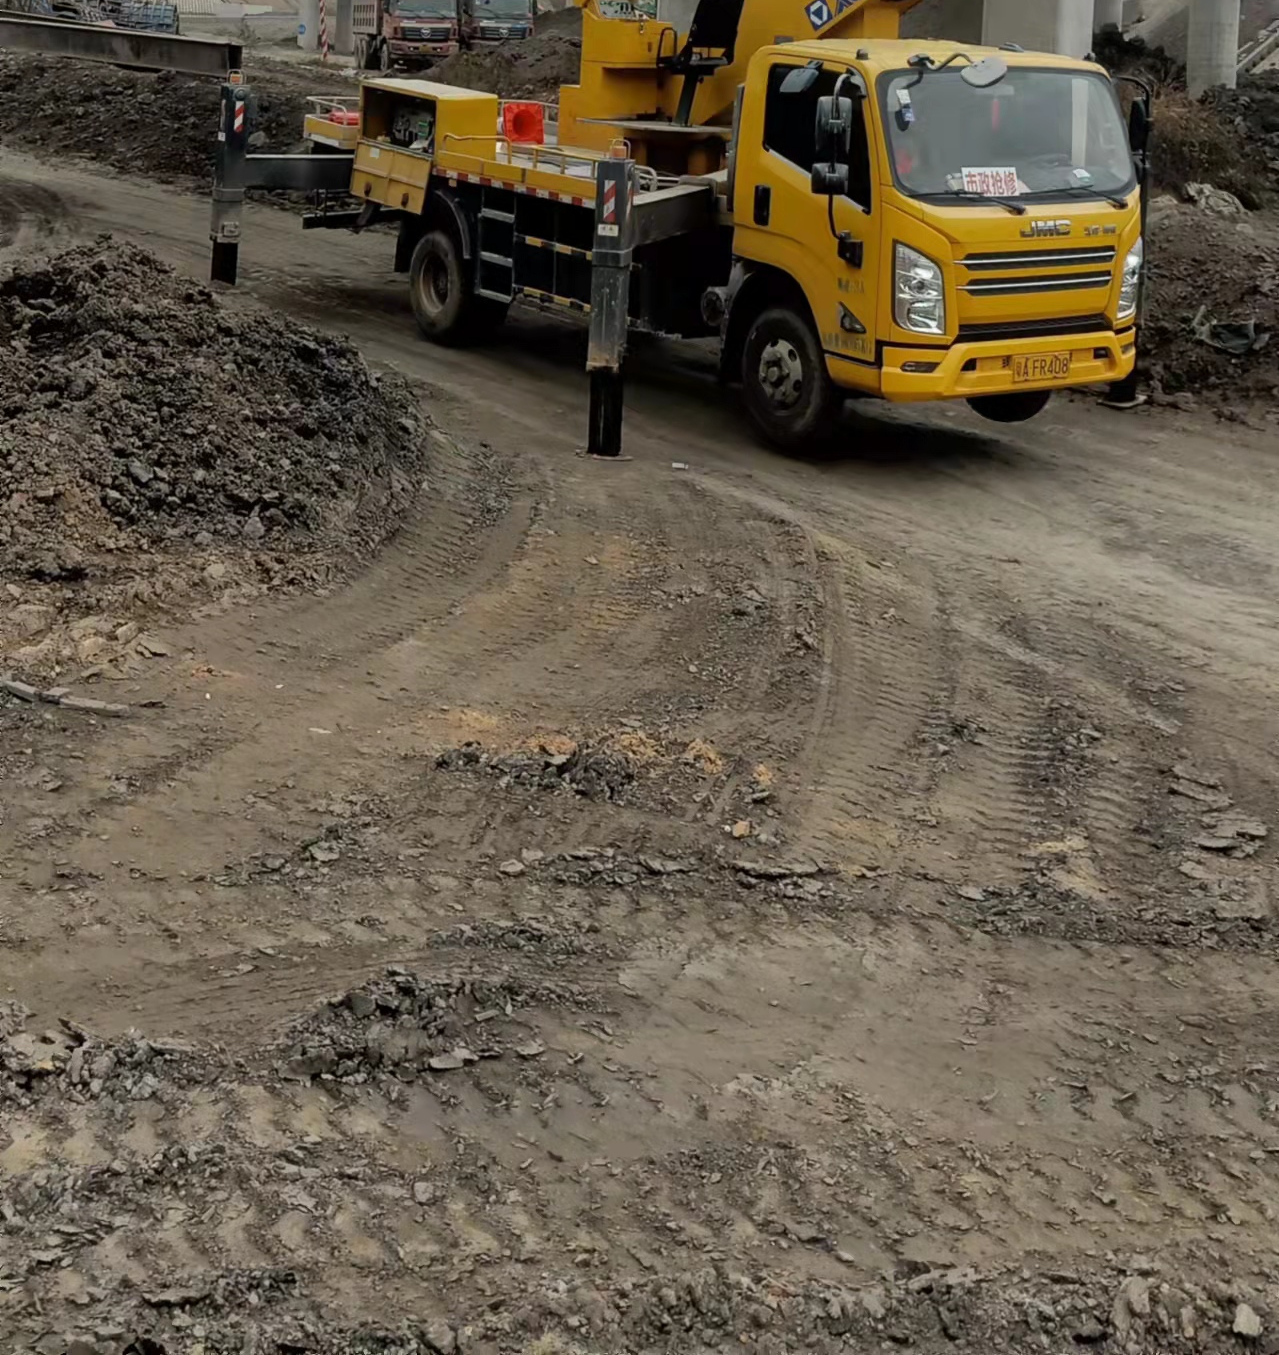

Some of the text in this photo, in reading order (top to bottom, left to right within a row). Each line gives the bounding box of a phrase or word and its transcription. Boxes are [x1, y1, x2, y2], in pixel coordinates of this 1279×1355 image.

[965, 171, 1018, 195] 市政抢修
[1019, 219, 1072, 238] JMC
